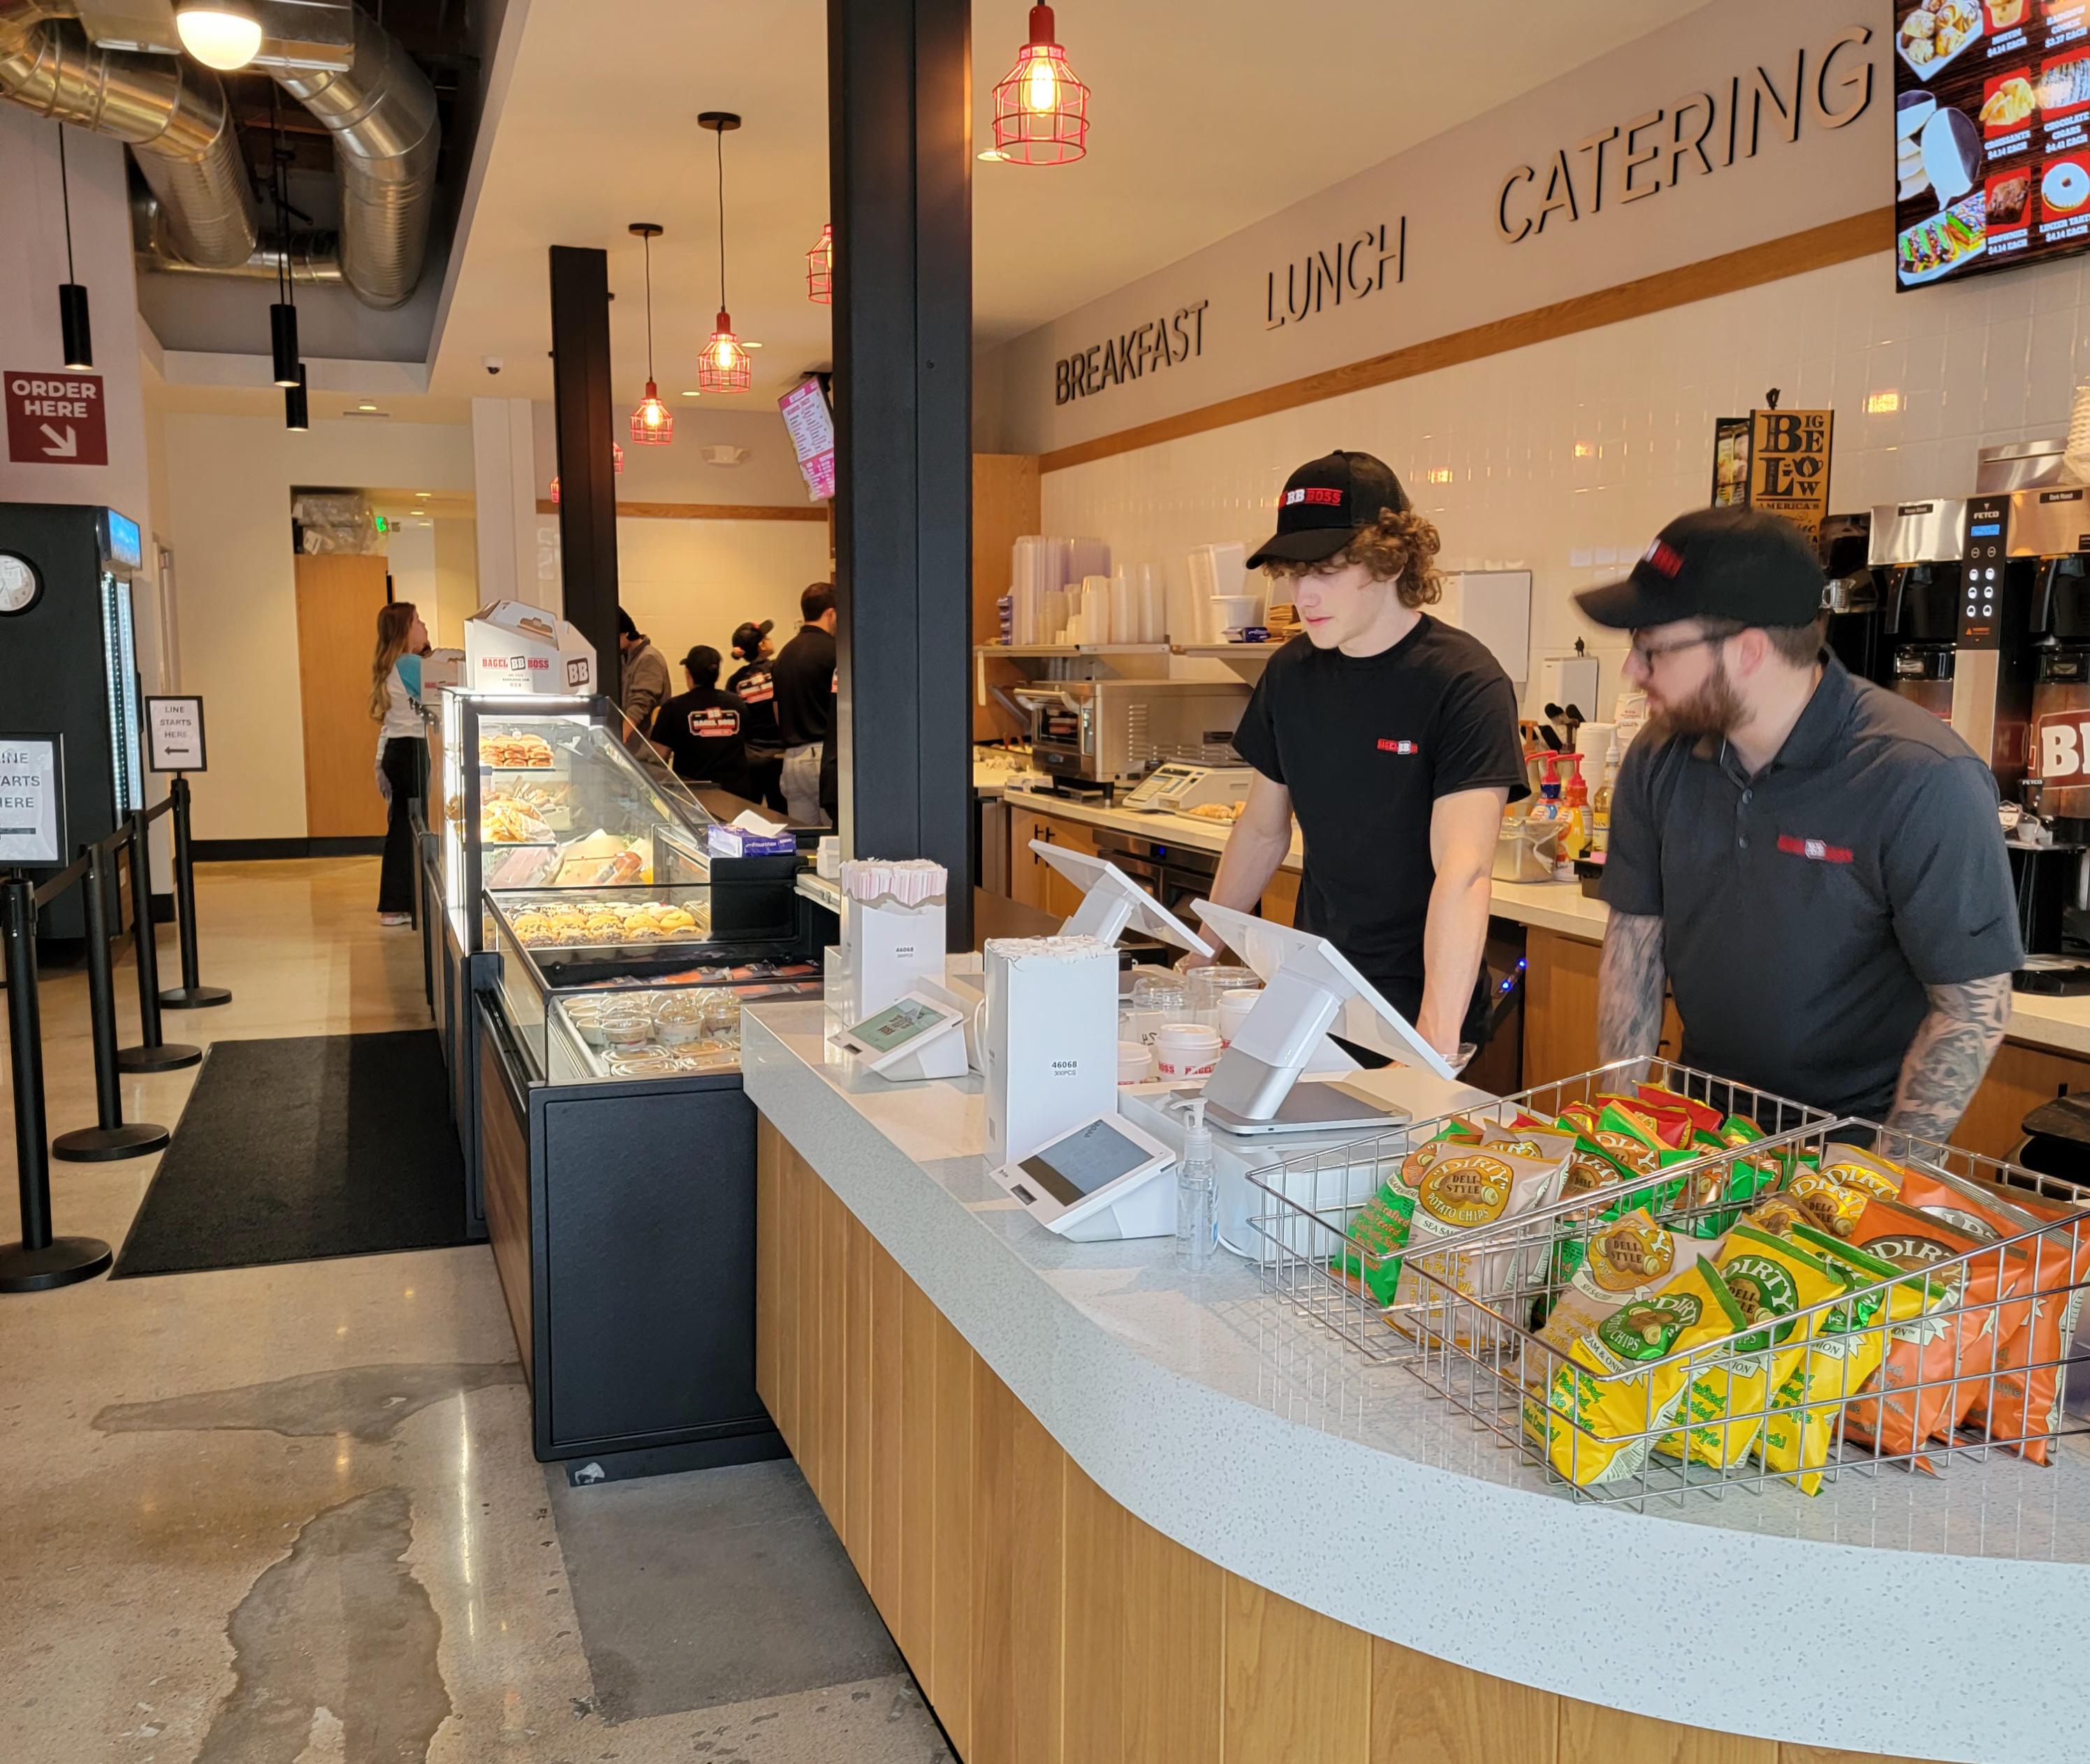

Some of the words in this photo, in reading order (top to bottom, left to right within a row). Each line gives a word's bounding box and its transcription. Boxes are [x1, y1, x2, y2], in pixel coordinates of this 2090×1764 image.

[1494, 26, 1874, 244] CATERING
[1265, 216, 1406, 330] LUNCH
[1055, 300, 1208, 405] BREAKFAST
[12, 379, 96, 399] ORDER
[24, 400, 88, 418] HERE
[1306, 491, 1341, 503] BOSS
[1973, 511, 1999, 520] FETCO
[483, 659, 508, 667] BAGEL
[528, 660, 549, 668] BOSS
[568, 661, 589, 684] BB
[0, 753, 29, 763] INE
[0, 776, 41, 786] ARTS
[1453, 1175, 1477, 1184] DELI
[1574, 1177, 1591, 1189] DELI
[1447, 1184, 1479, 1194] STYLE
[1426, 1193, 1456, 1218] POTATO
[1459, 1208, 1489, 1221] CHIPS
[1809, 1201, 1832, 1212] DELI
[1423, 1220, 1438, 1231] SEA
[1611, 1251, 1642, 1263] STYLE
[1610, 1330, 1640, 1351] CHIPS
[1599, 1350, 1606, 1360] &
